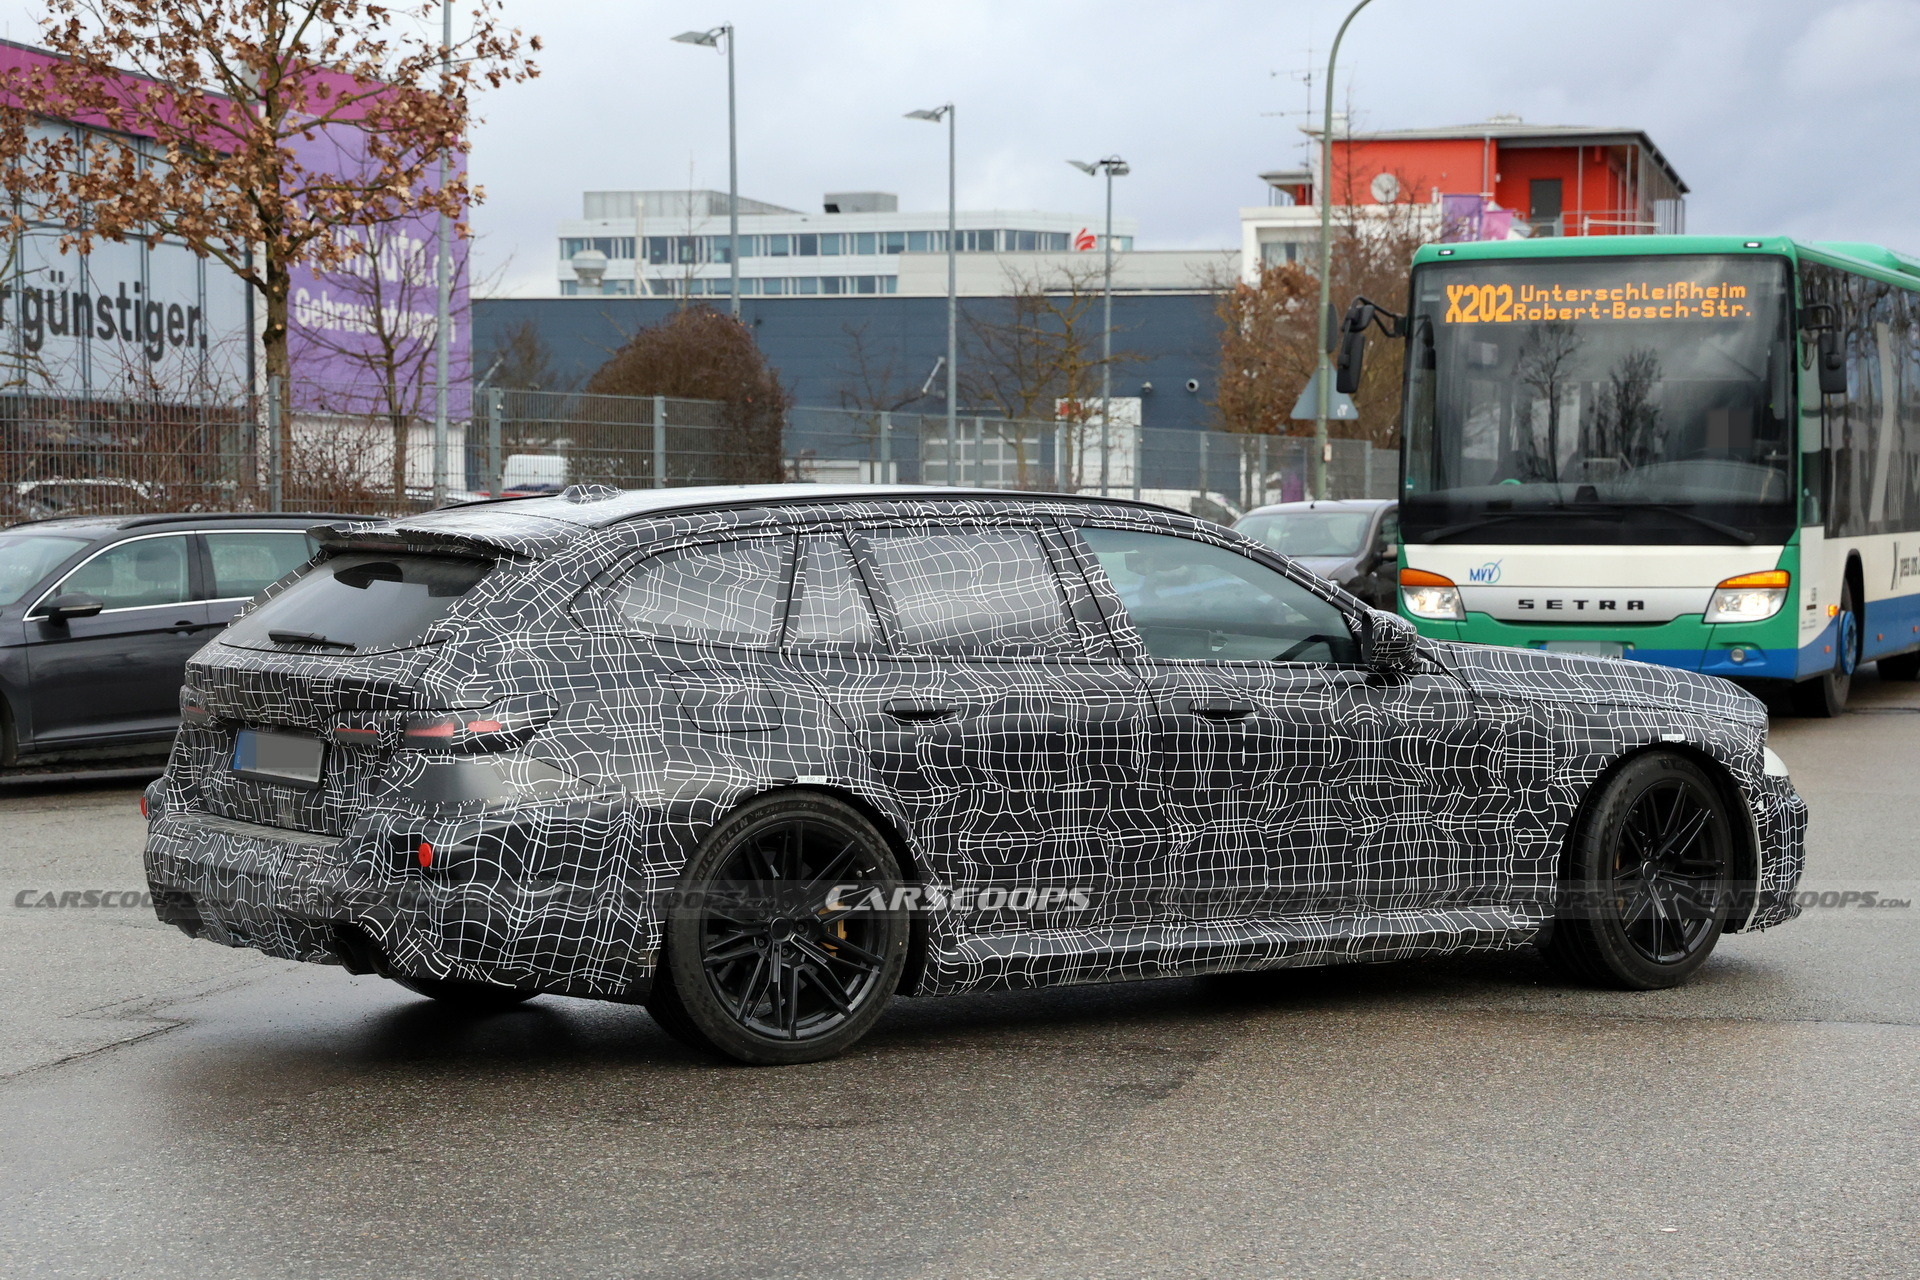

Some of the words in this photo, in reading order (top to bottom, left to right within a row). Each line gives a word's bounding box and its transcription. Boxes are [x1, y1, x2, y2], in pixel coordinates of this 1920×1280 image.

[1445, 284, 1512, 323] X202
[1520, 281, 1747, 303] Unterschleißheim
[22, 270, 208, 362] günstiger.
[1512, 298, 1752, 321] Robert-Bosch-Str.
[1469, 559, 1503, 582] MVV
[1518, 599, 1644, 610] SETRA
